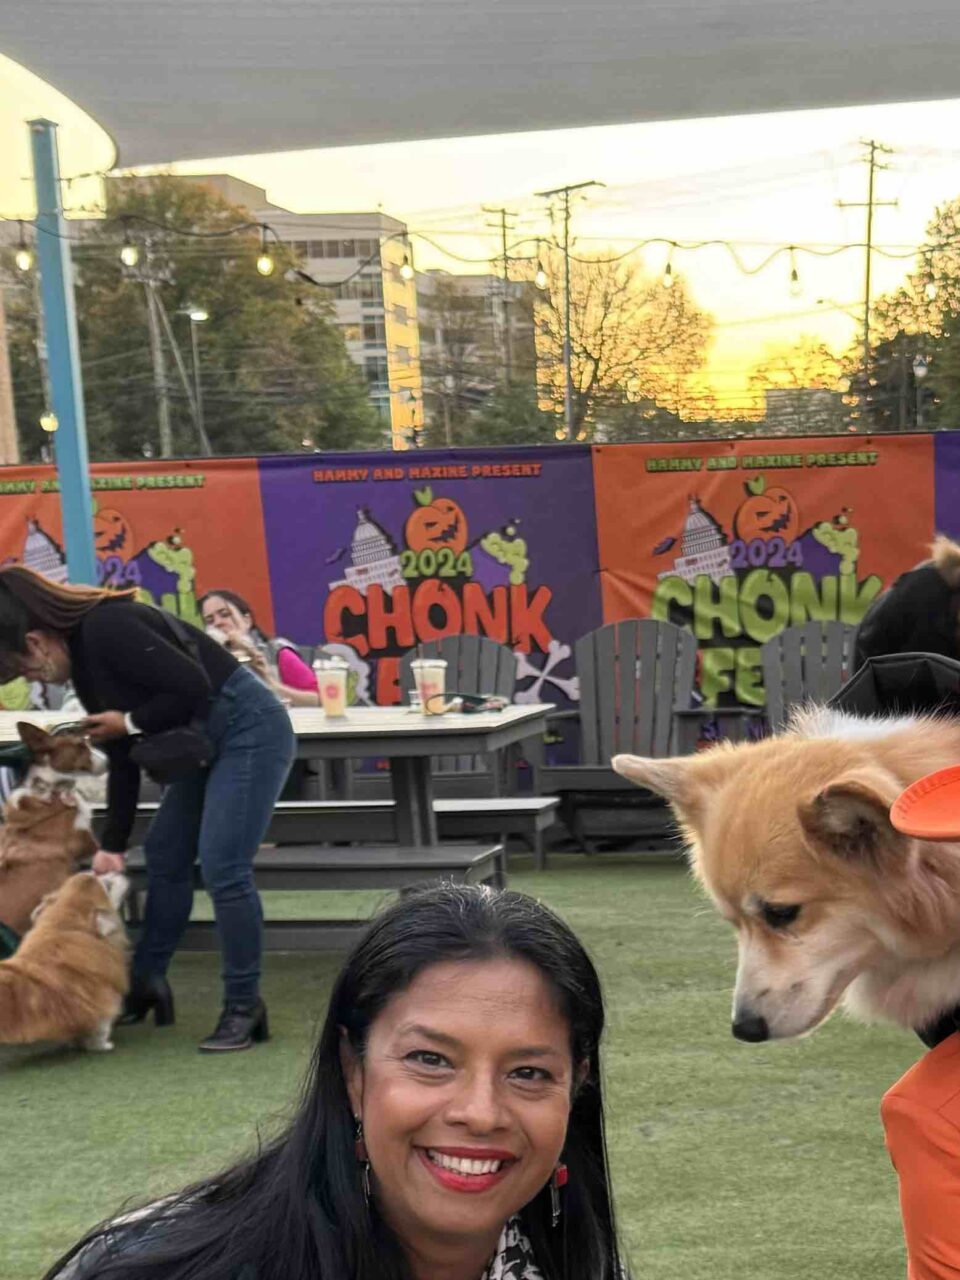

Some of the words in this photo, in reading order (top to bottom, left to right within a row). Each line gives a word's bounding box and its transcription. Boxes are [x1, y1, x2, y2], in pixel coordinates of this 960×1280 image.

[313, 468, 368, 483] HAMMY
[373, 466, 404, 480] AND
[409, 465, 468, 479] MAXINE
[472, 463, 541, 478] PRESENT
[646, 458, 702, 473] HAMMY
[707, 456, 738, 471] AND
[742, 454, 802, 469] MAXINE
[806, 451, 878, 467] PRESENT
[136, 474, 205, 489] PRESENT
[401, 547, 473, 578] 2024
[730, 537, 804, 568] 2024
[323, 578, 553, 657] CHONK
[701, 647, 766, 709] FE
